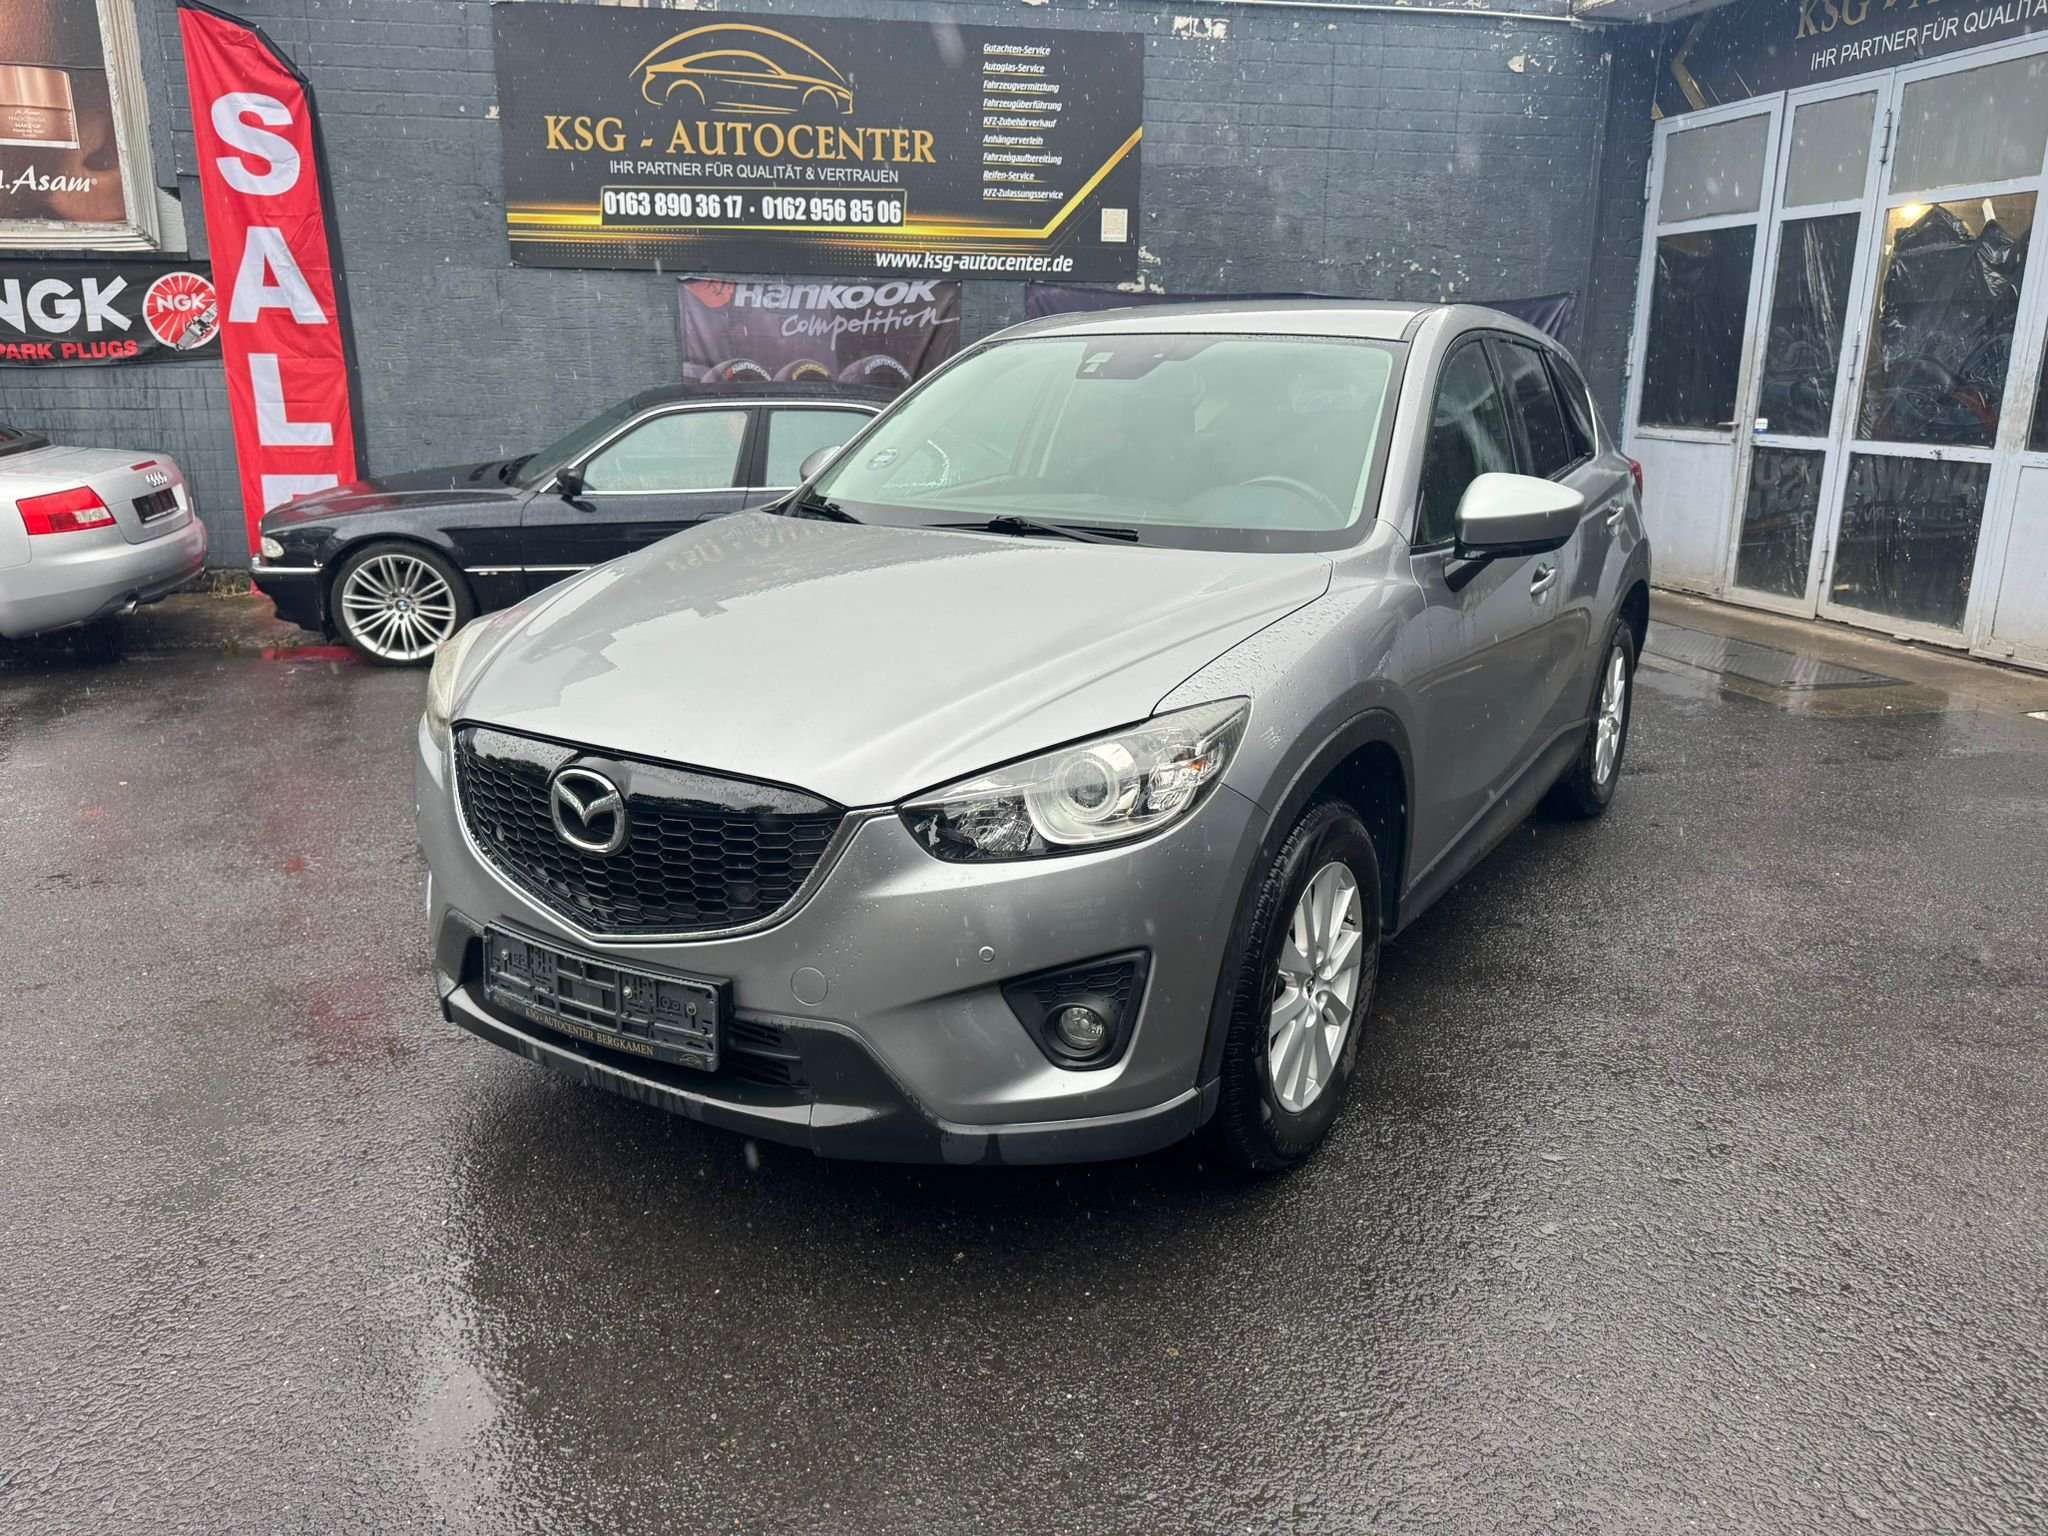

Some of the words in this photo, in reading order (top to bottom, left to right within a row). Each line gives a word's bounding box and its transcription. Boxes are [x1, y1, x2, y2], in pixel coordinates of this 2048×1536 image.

[983, 43, 1051, 55] Gutachten-Service
[1810, 47, 1837, 71] IHR
[1840, 28, 1918, 64] PARTNER
[1921, 17, 1959, 45] FÜR
[983, 62, 1045, 73] Autoglas-Service
[983, 80, 1060, 93] Fahrzeugvermittlung
[983, 98, 1062, 112] Fahrzeugüberführung
[983, 117, 1057, 128] KFZ-Zubehörverkauf
[544, 115, 626, 153] KSG
[666, 119, 936, 163] AUTOCENTER
[983, 135, 1044, 145] Anhängerverleih
[983, 152, 1062, 165] Fahrzeugaufbereitung
[609, 160, 634, 174] IHR
[637, 161, 701, 176] PARTNER
[705, 161, 733, 177] FÜR
[736, 163, 802, 180] QUALITÄT
[805, 167, 815, 180] &
[817, 167, 899, 183] VERTRAUEN
[983, 170, 1035, 180] Reifen-Service
[983, 188, 1064, 199] KFZ-Zulassungsservice
[604, 191, 651, 215] 0163
[654, 192, 693, 216] 890
[696, 193, 721, 218] 36
[724, 195, 743, 218] 17
[762, 196, 806, 220] 0162
[809, 197, 846, 222] 956
[850, 199, 874, 223] 85
[877, 200, 902, 224] 06
[876, 252, 1073, 273] www.ksg-autocenter.de
[156, 293, 207, 313] NGK
[781, 307, 960, 350] Competition
[61, 340, 139, 359] PLUGS
[543, 1015, 595, 1041] AUTOCENTER
[597, 1033, 655, 1056] BERGKAMEN
